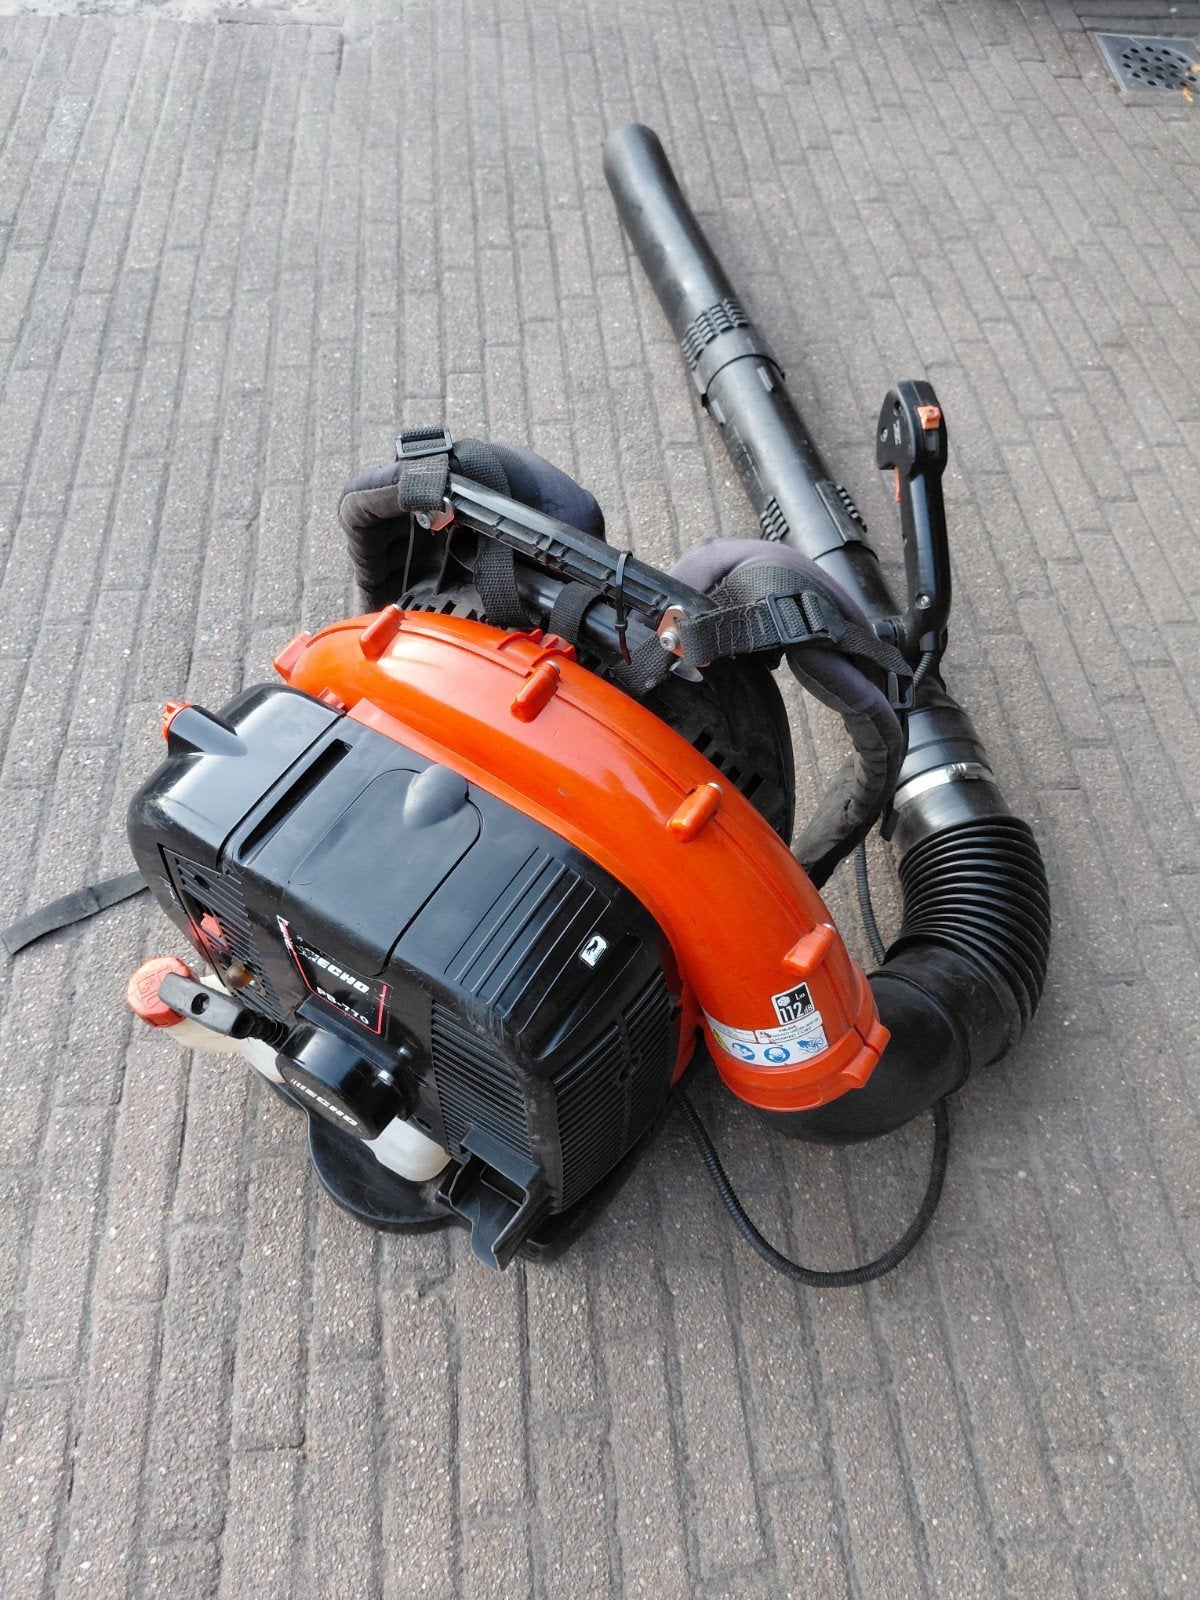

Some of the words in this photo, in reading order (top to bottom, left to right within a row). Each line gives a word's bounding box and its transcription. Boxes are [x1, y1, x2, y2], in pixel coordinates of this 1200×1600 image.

[316, 958, 370, 994] ECHO
[316, 986, 369, 1025] PB-770
[779, 1001, 805, 1022] 112
[307, 1089, 358, 1127] ECHO
